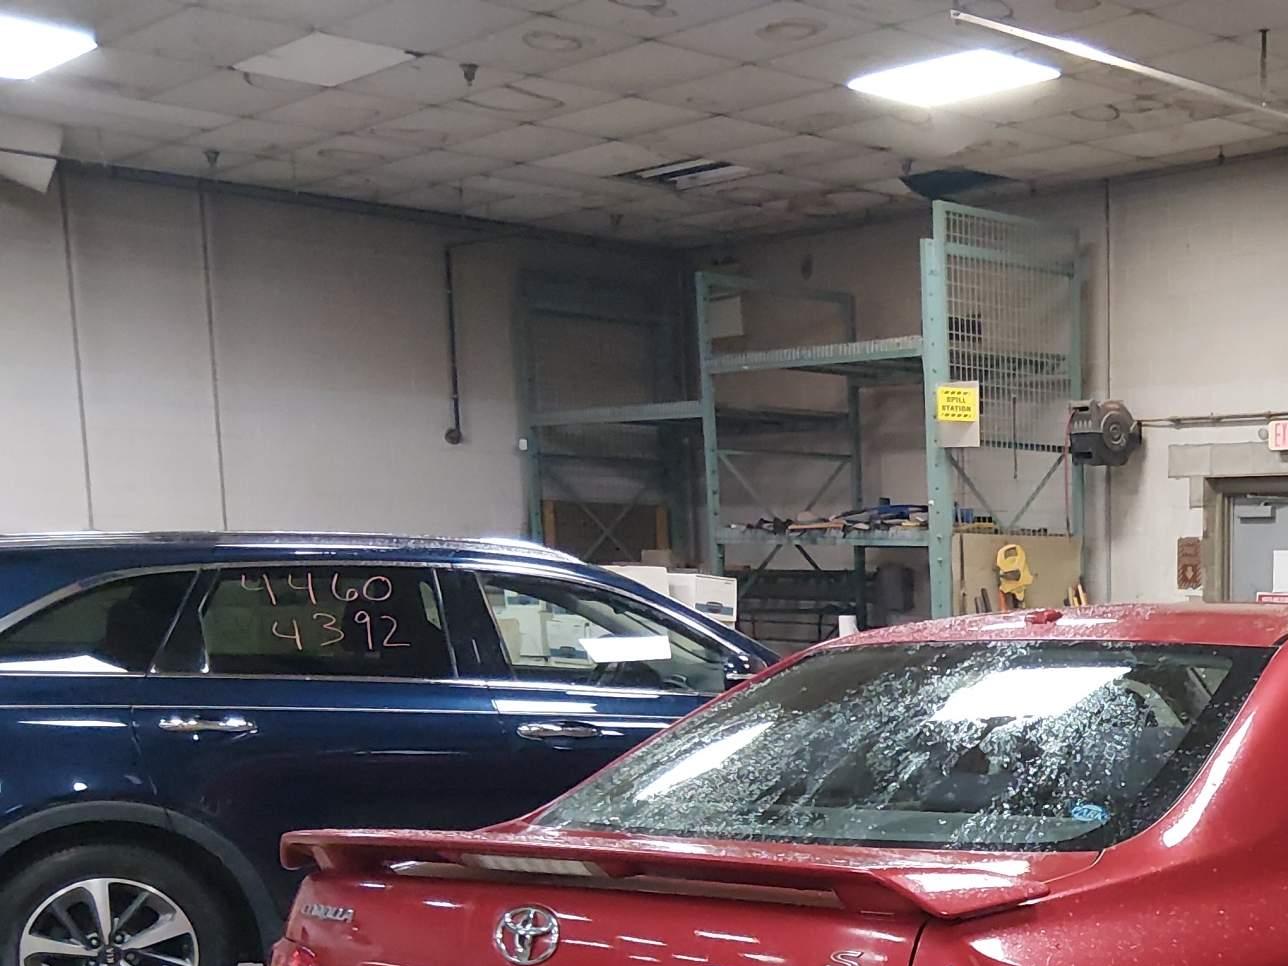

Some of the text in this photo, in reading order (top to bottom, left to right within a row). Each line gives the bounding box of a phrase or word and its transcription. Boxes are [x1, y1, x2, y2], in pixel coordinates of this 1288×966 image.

[941, 404, 971, 412] STATION
[240, 572, 393, 605] 4460
[271, 610, 410, 650] 4392
